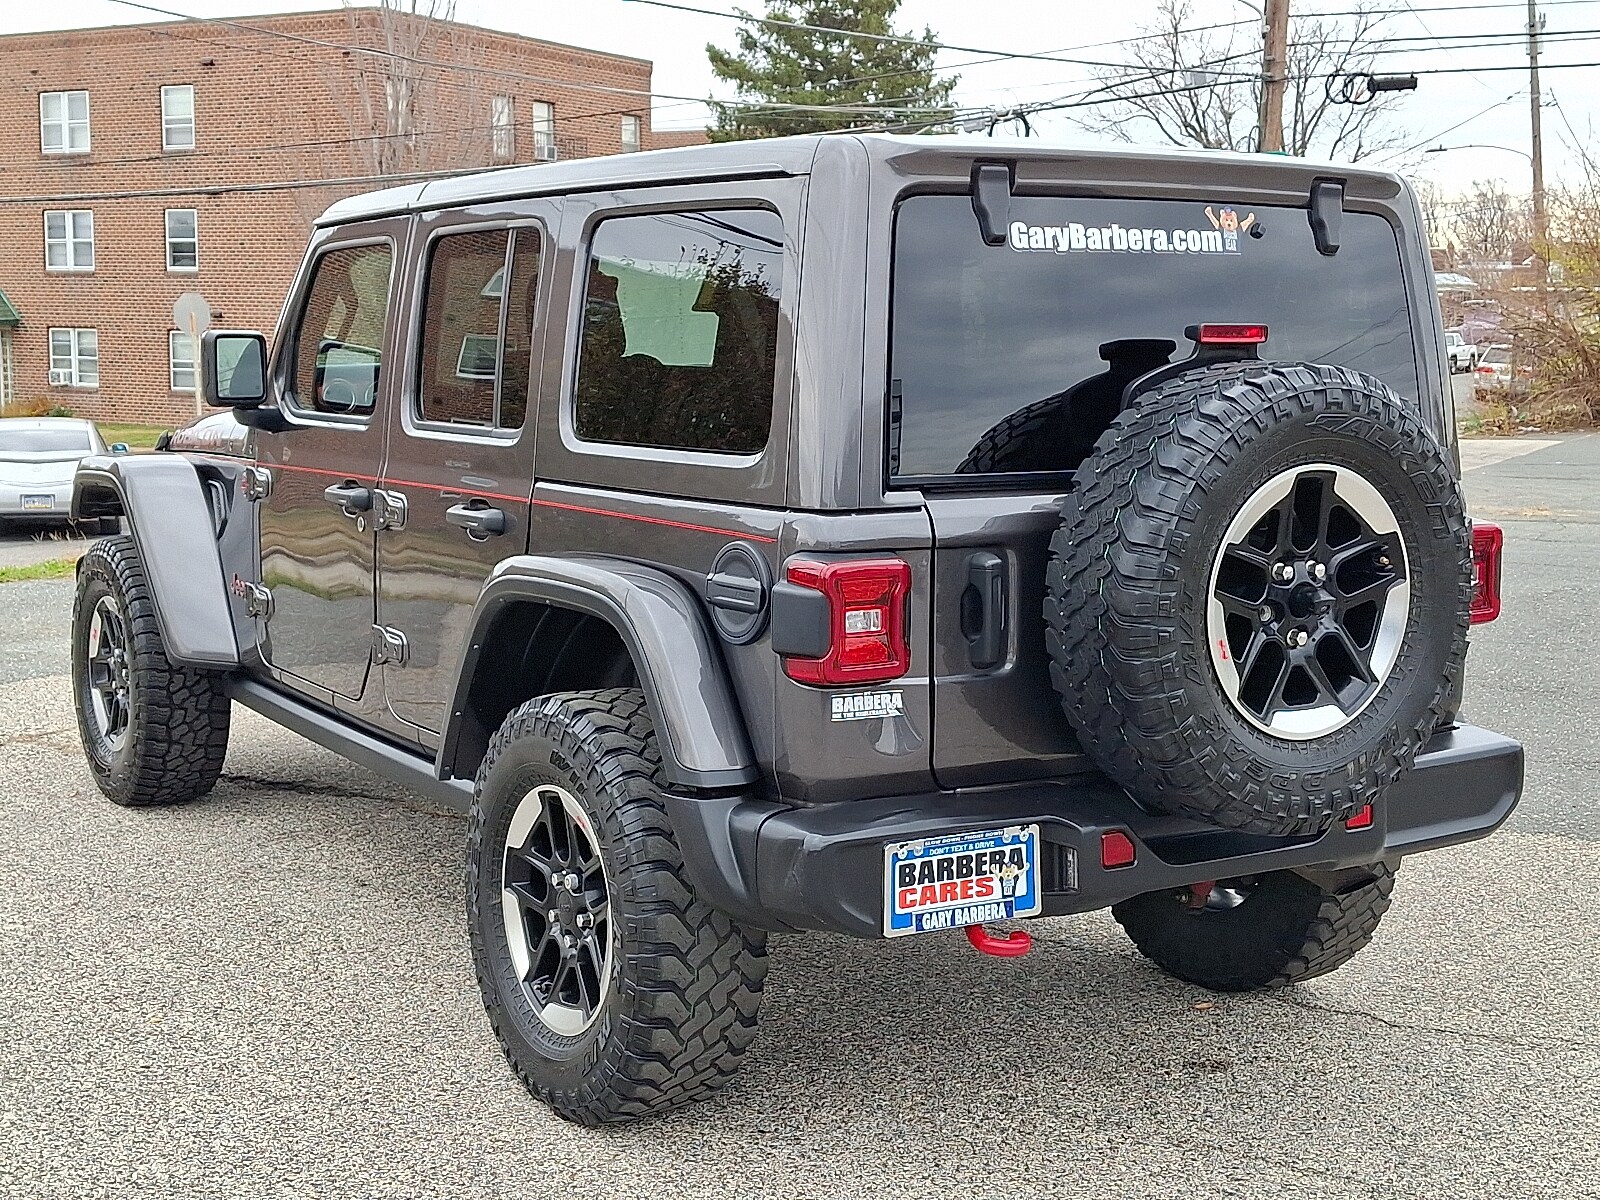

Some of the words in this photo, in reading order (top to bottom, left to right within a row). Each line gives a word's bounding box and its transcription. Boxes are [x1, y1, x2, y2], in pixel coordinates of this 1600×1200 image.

[1009, 221, 1224, 254] GaryBarbera.com
[832, 692, 903, 713] BARBERA
[929, 847, 949, 856] DON'T
[951, 843, 968, 852] TEXT
[974, 840, 995, 849] DRIVE
[899, 847, 1024, 888] BARBERA
[899, 877, 994, 909] CARES
[922, 909, 953, 930] GARY
[954, 901, 1007, 925] BARBERA
